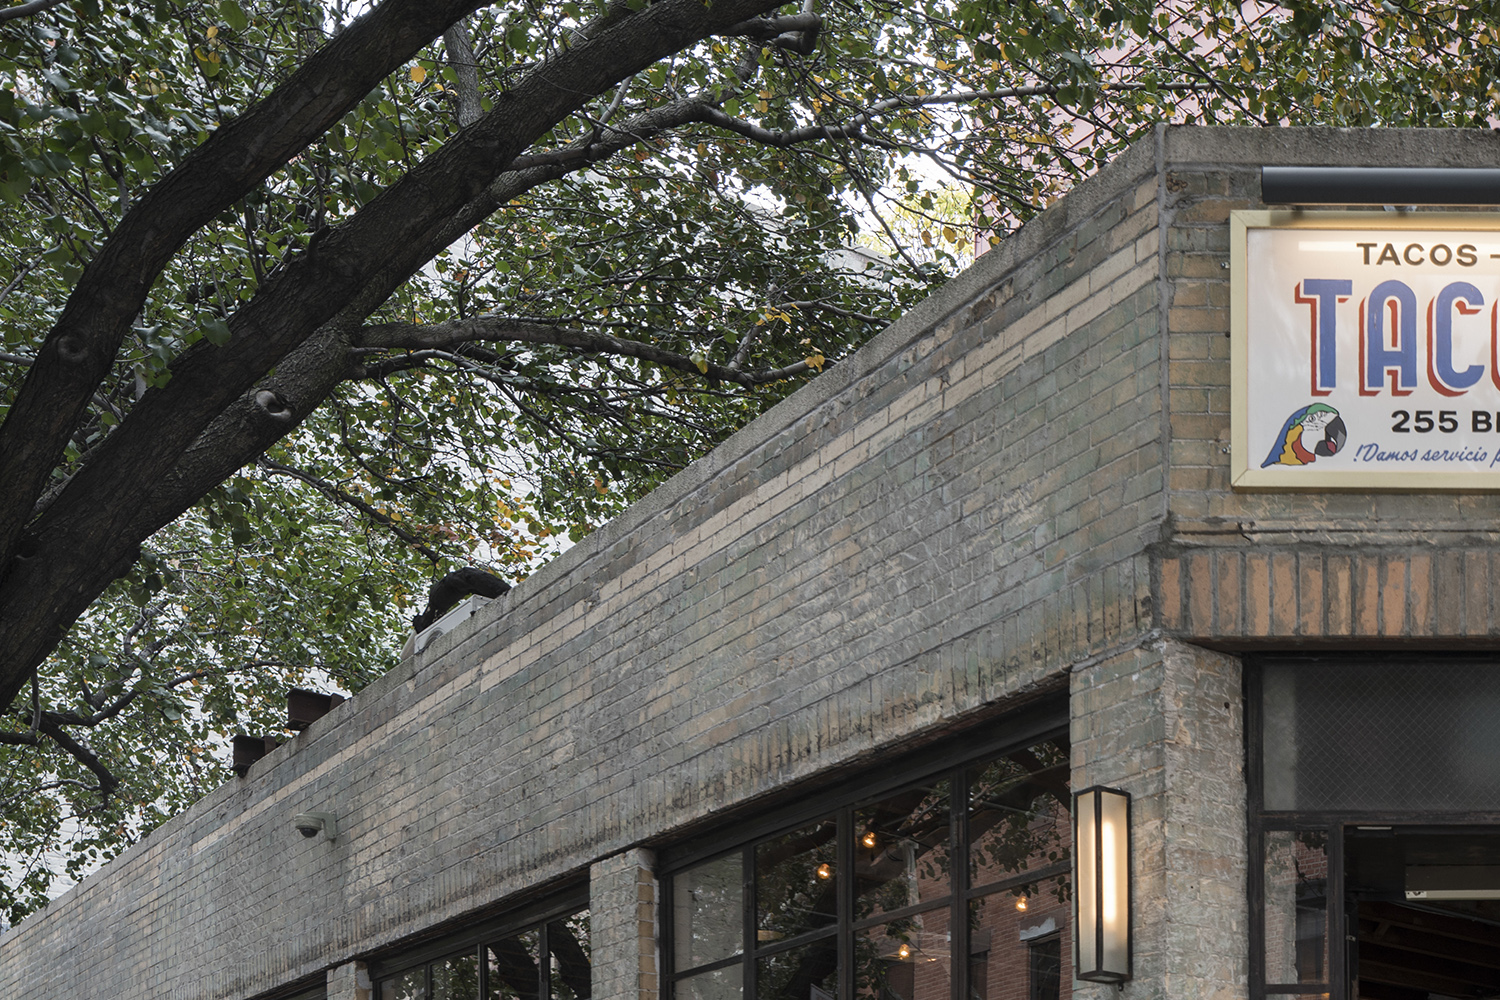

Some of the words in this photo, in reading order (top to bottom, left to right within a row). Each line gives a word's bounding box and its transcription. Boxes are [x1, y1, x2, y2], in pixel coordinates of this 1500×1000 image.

[1356, 242, 1479, 267] TACOS
[1391, 410, 1459, 434] 255
[1421, 446, 1488, 463] servicio
